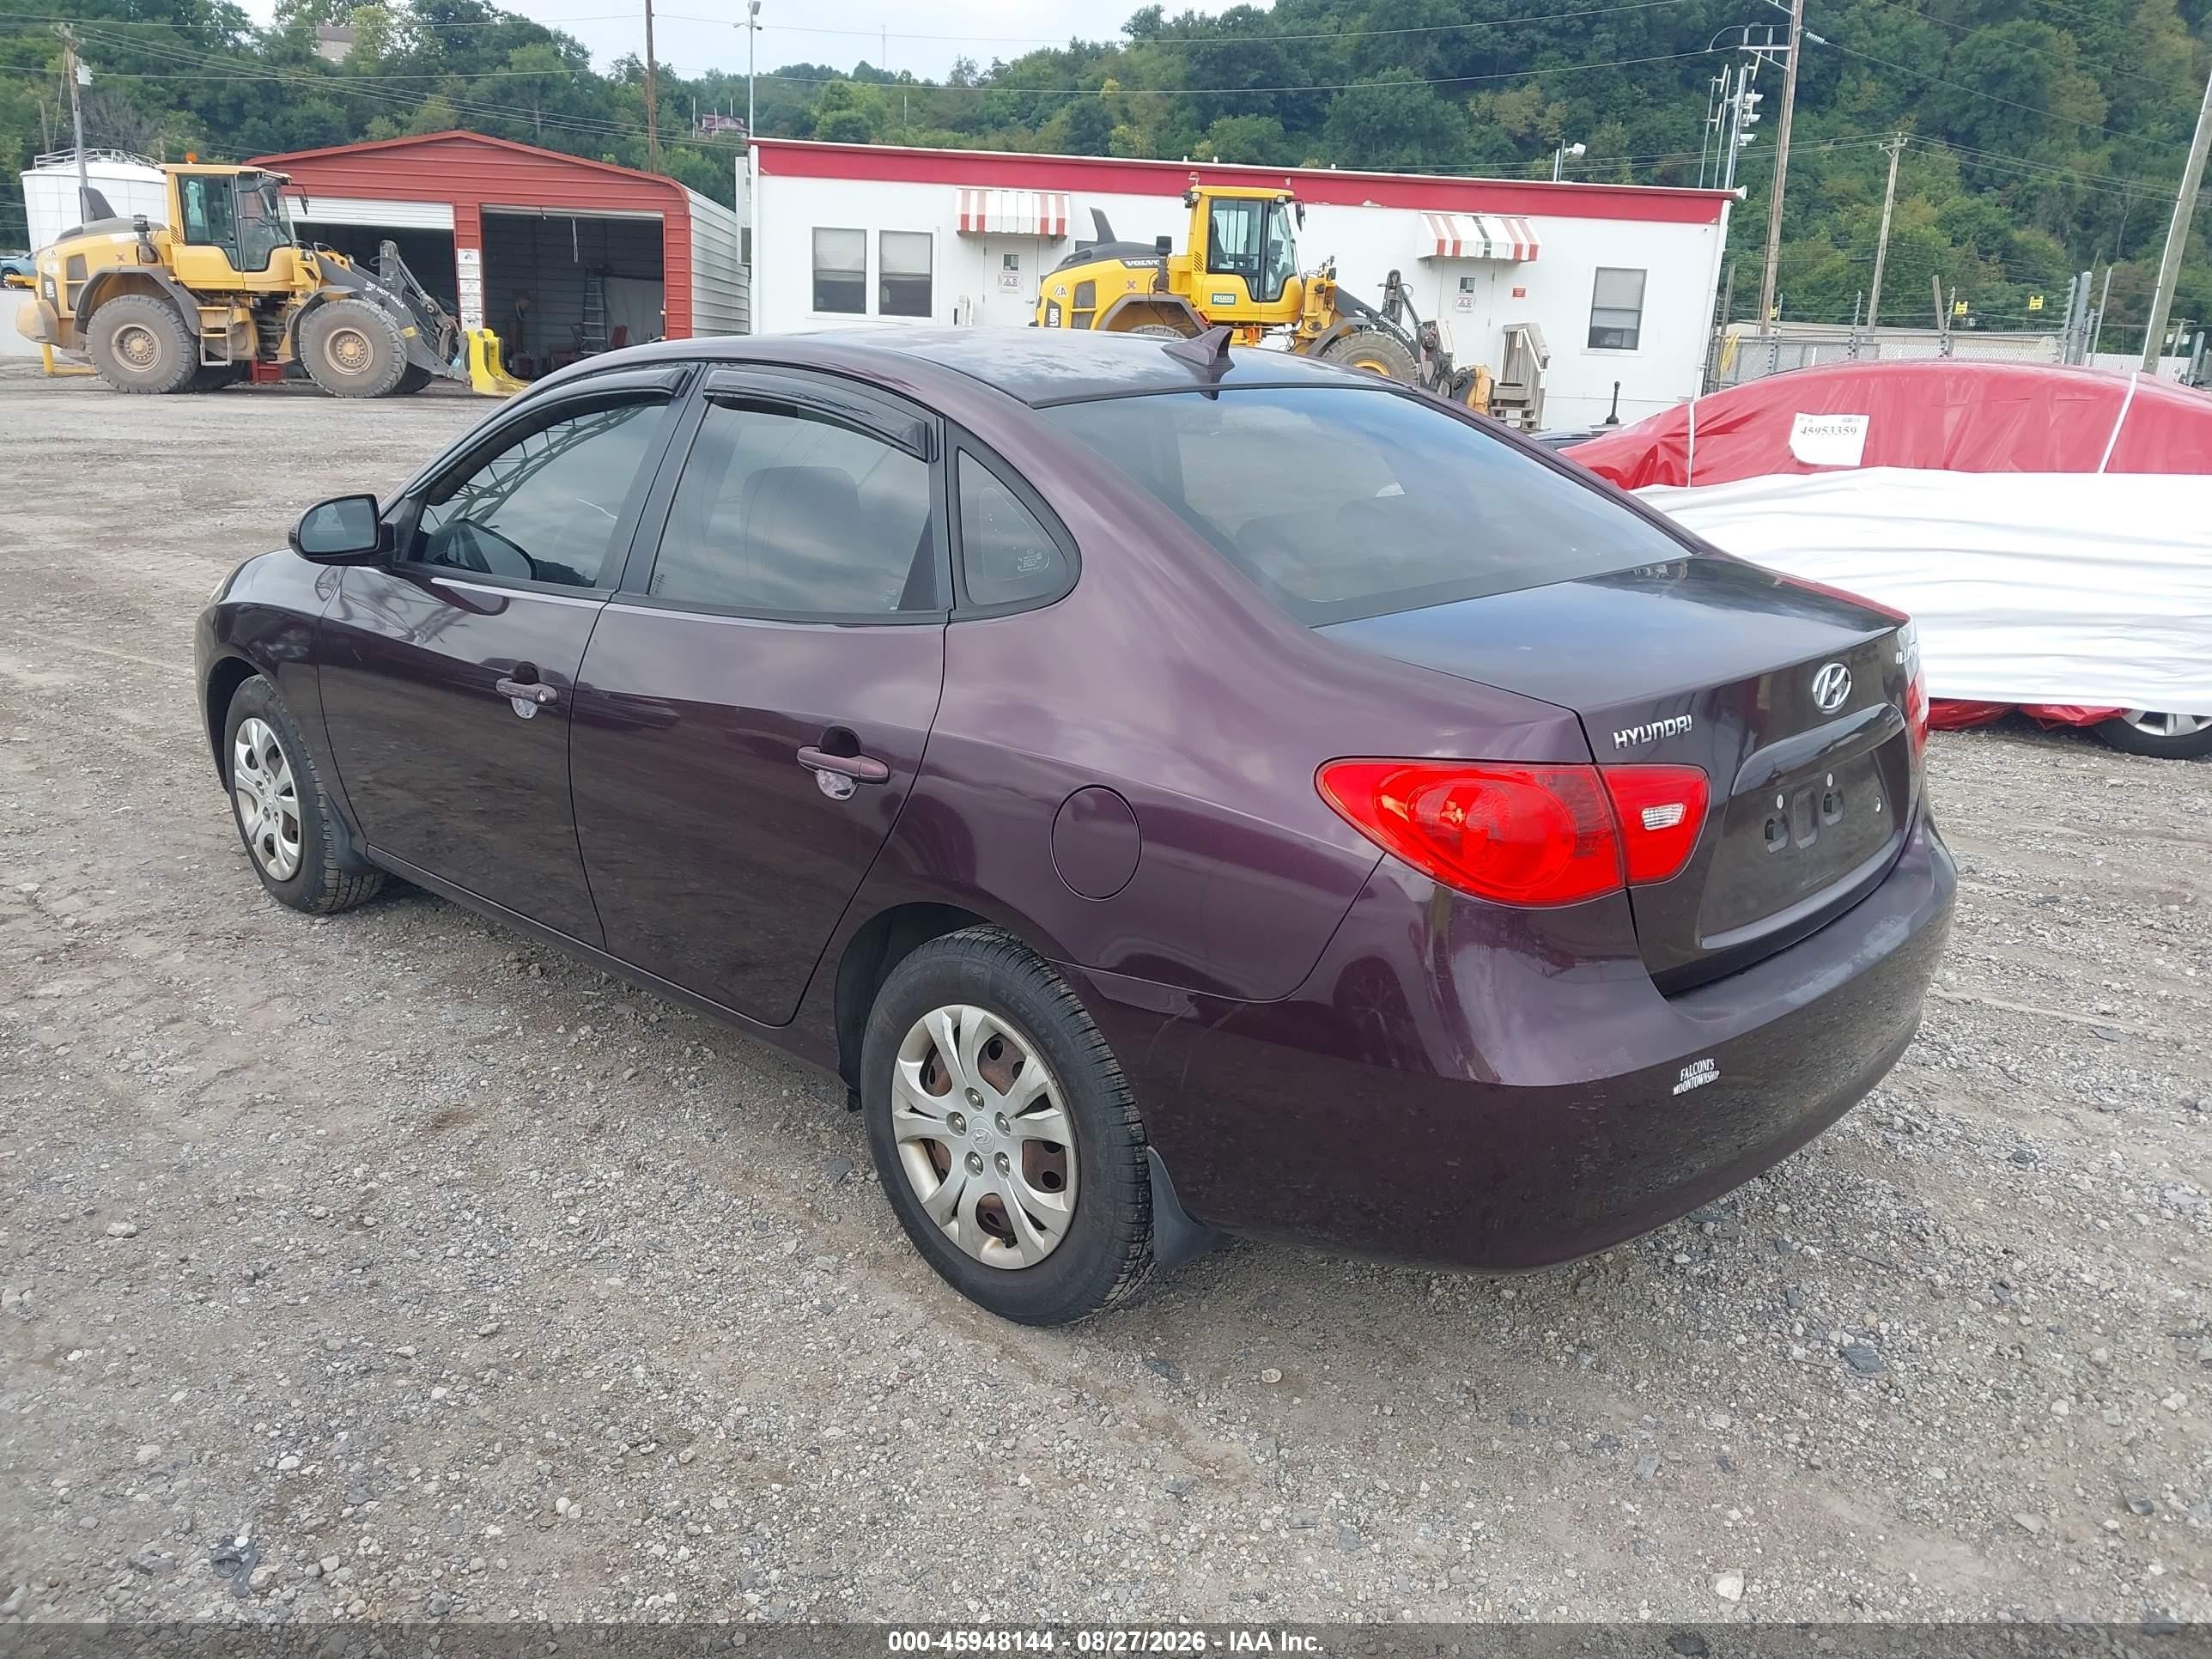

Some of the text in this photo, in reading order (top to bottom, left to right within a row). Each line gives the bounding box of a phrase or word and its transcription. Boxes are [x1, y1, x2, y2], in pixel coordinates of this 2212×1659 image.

[366, 281, 406, 309] DO NOT WALK
[1800, 425, 1857, 435] 45953359
[1613, 714, 1692, 750] HYUNDAI
